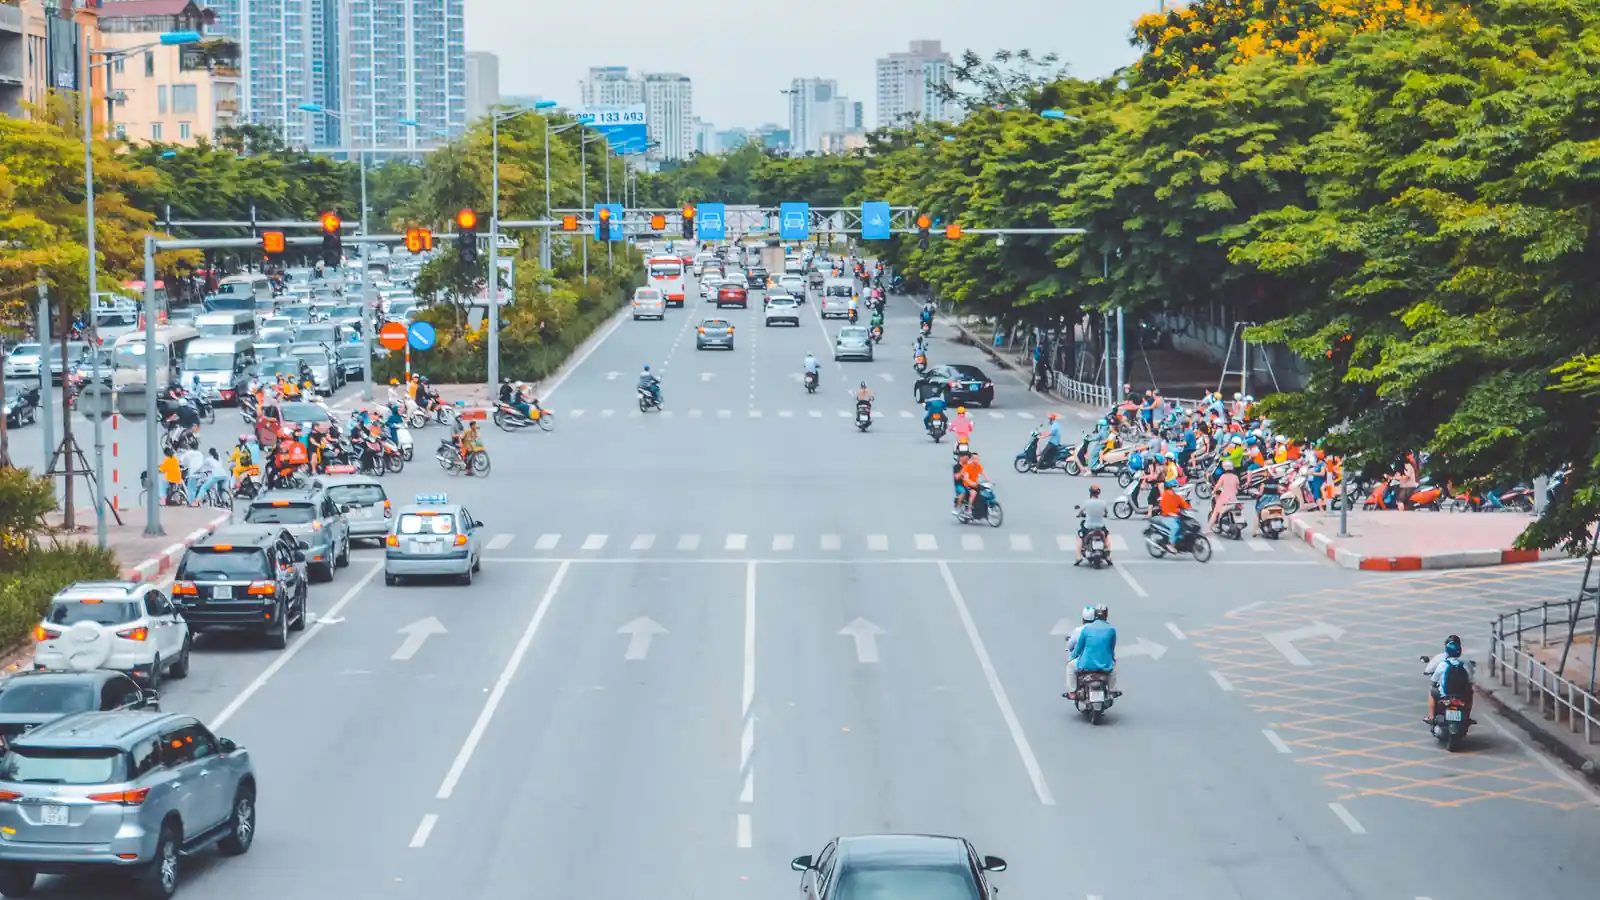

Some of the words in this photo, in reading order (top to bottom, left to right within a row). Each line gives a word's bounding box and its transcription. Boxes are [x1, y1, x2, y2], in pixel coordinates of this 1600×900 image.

[601, 112, 619, 122] 133
[624, 112, 643, 121] 493
[408, 231, 431, 251] 67
